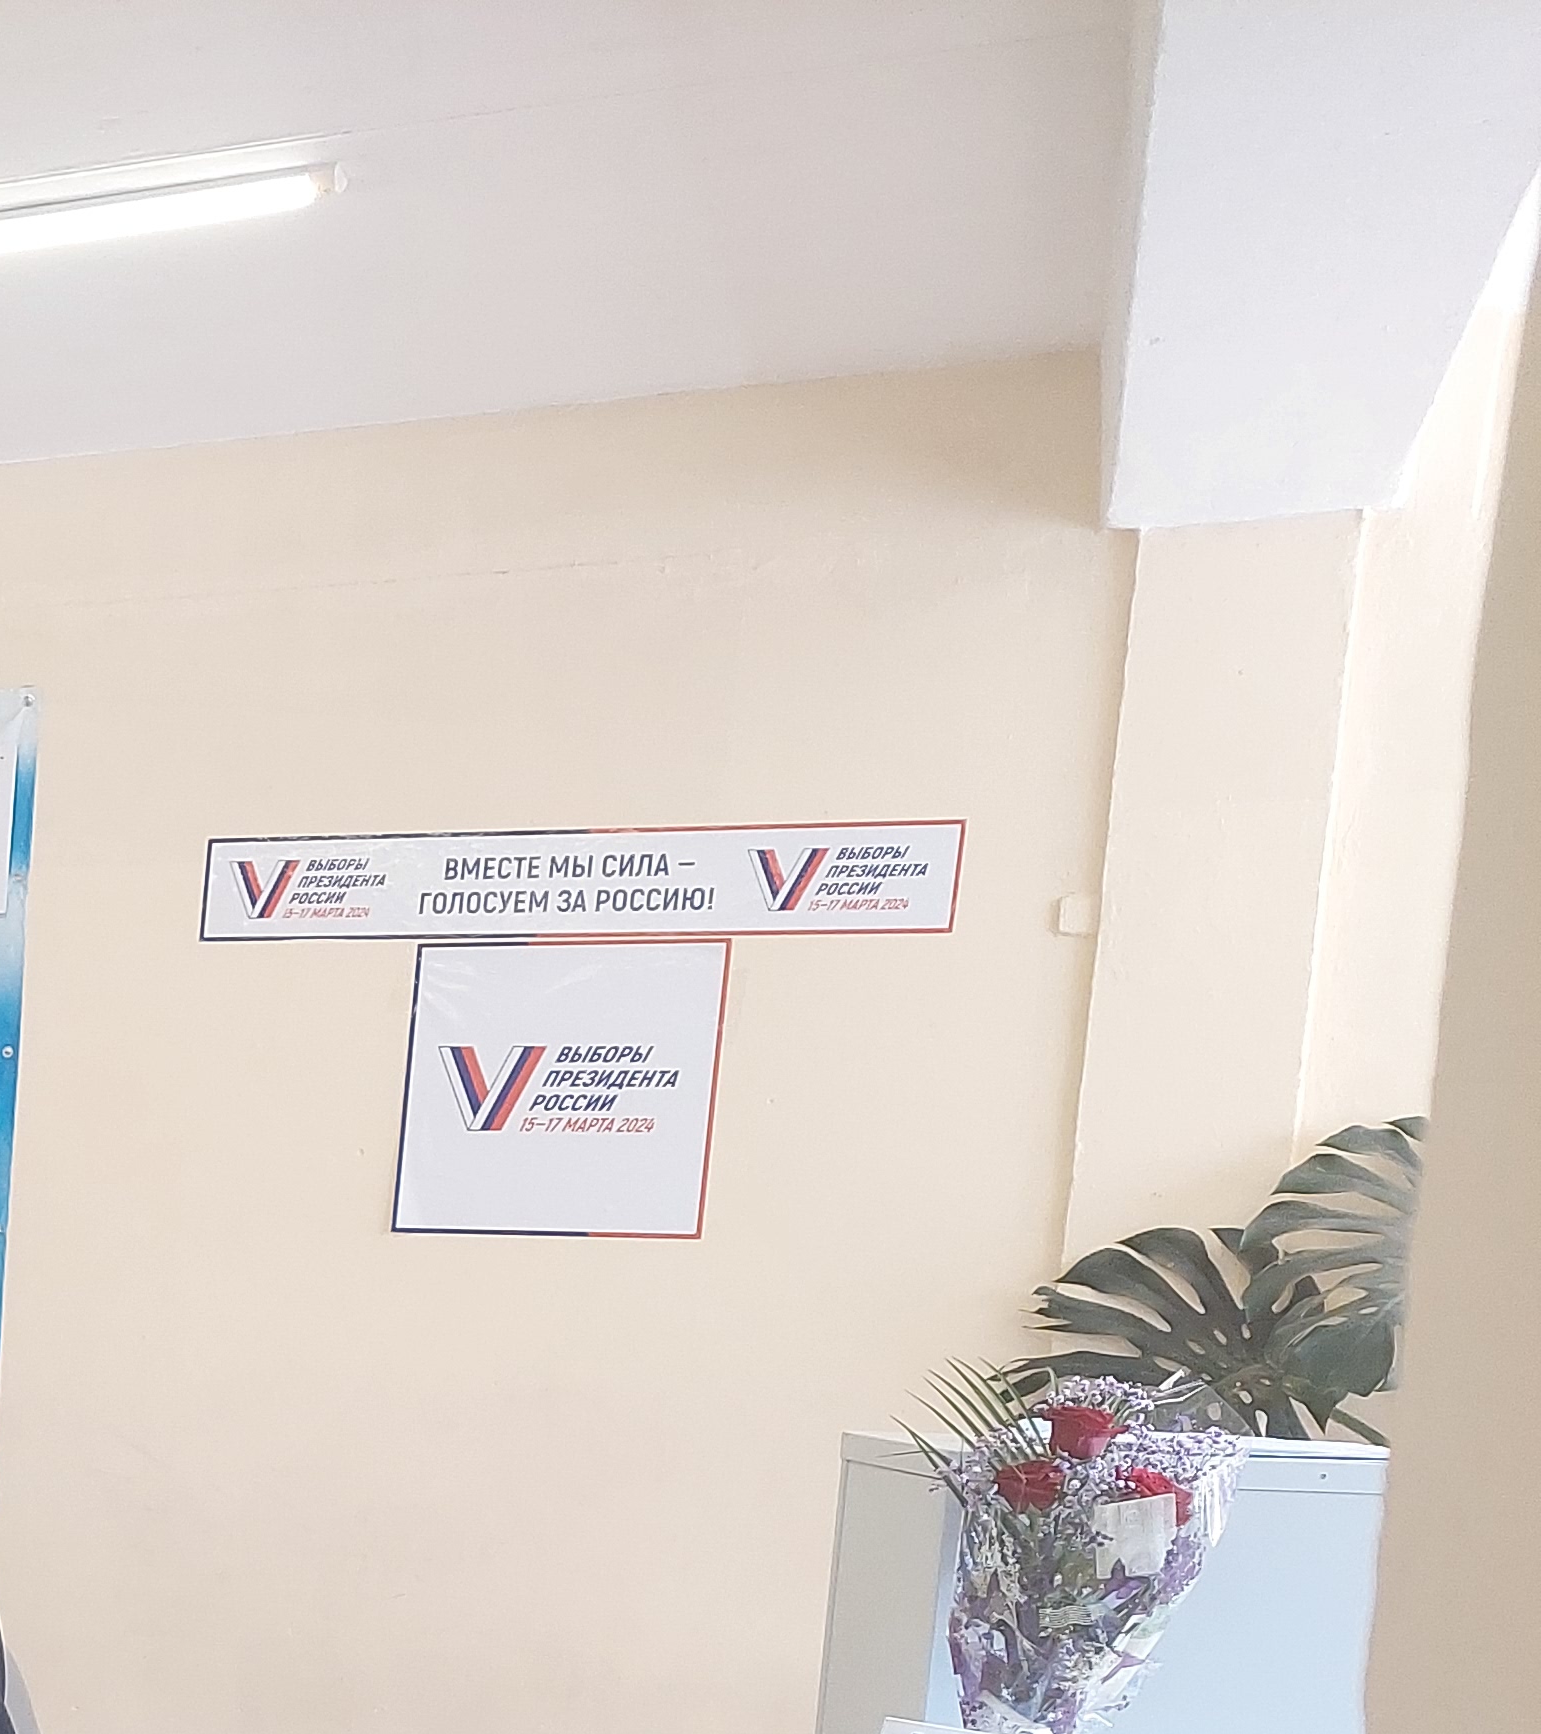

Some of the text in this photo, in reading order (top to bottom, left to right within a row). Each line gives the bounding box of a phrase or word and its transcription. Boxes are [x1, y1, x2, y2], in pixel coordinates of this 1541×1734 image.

[835, 845, 911, 861] ВЫБОРЫ
[306, 857, 370, 873] ВЫБОРЫ
[443, 855, 542, 881] ВМЕСТЕ
[547, 855, 594, 880] МЫ
[601, 853, 671, 878] СИЛА
[825, 862, 930, 880] ПРЕЗИДЕНТА
[297, 873, 388, 890] ПРЕЗИДЕНТА
[815, 881, 882, 897] РОССИИ
[288, 891, 348, 905] РОССИИ
[418, 886, 716, 916] ГОЛОСУЕМ ЗА РОССИЮ!
[554, 1045, 655, 1064] ВЫБОРЫ
[541, 1069, 681, 1091] ПРЕЗИДЕНТА
[528, 1093, 619, 1112] РОССИИ
[519, 1117, 656, 1134] 15–17 МАРТА 2024
